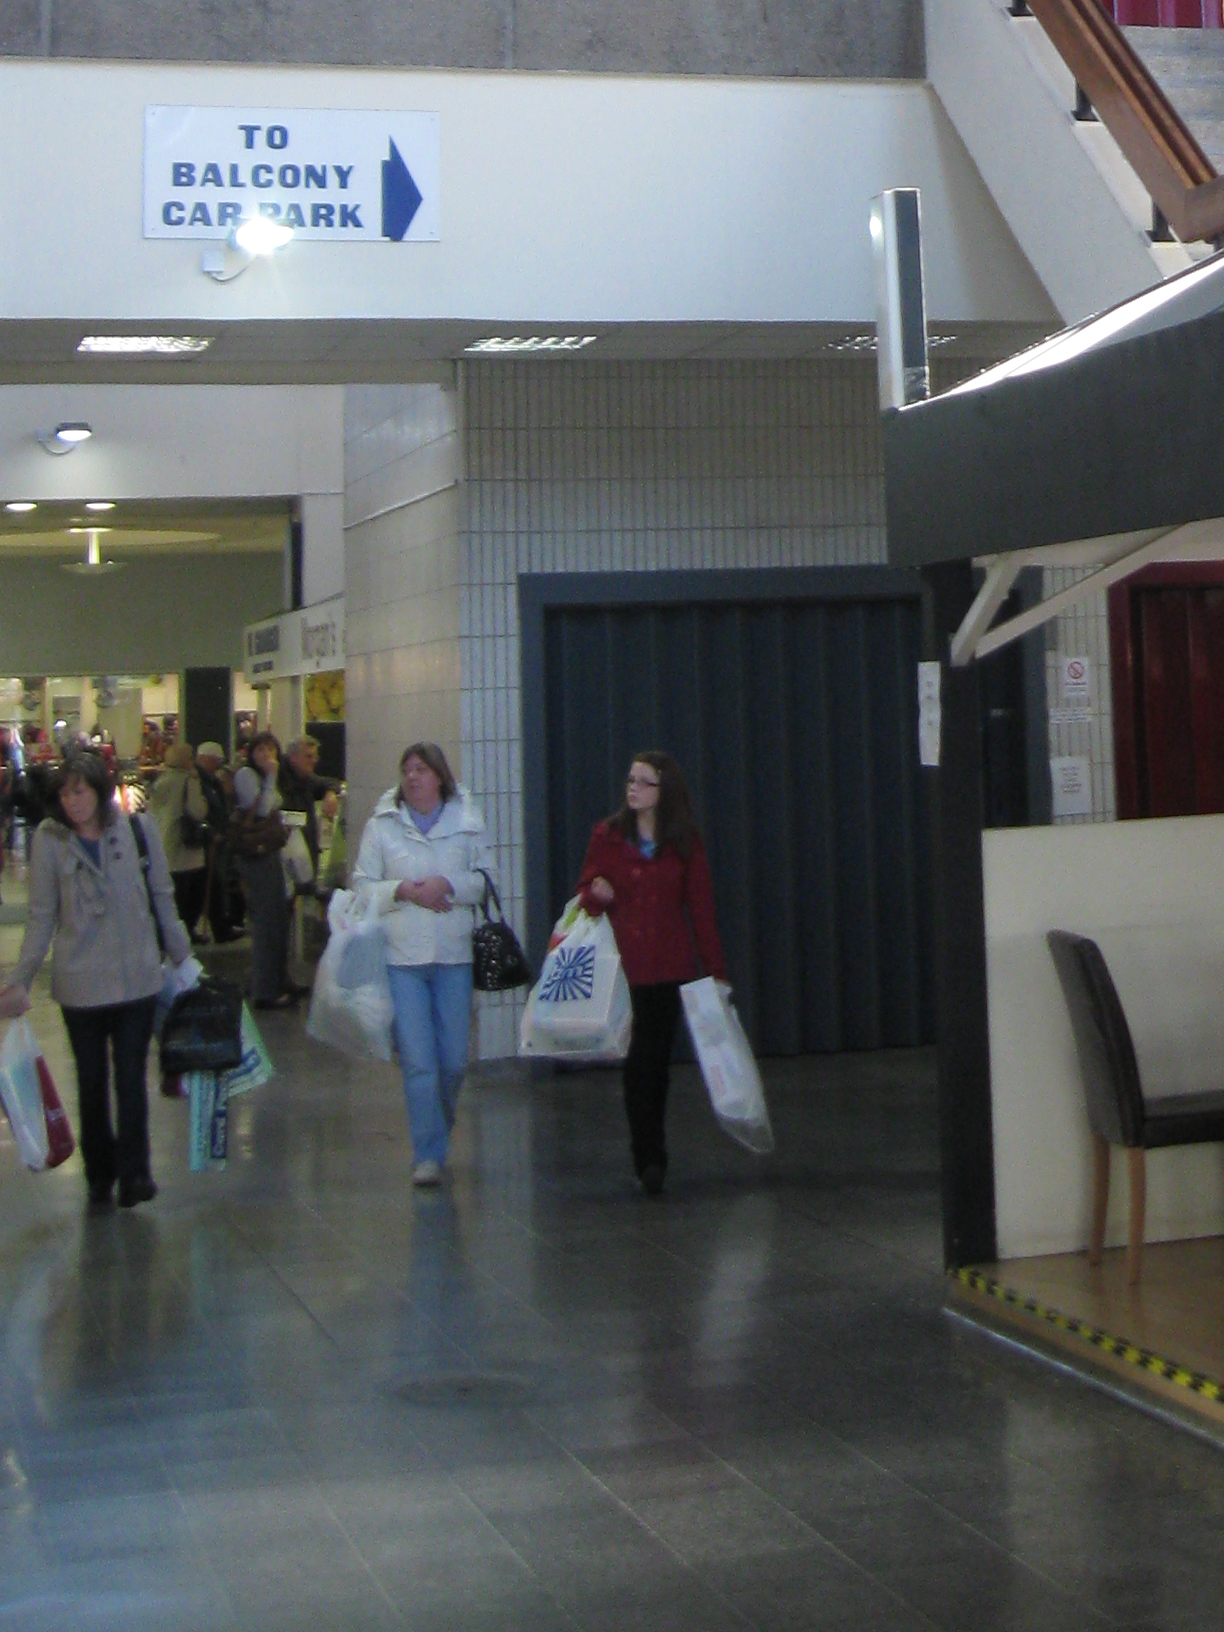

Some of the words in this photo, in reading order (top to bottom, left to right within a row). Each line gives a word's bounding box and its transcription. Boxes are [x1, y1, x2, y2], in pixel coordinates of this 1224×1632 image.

[238, 124, 289, 150] TO
[172, 161, 355, 190] BALCONY
[162, 200, 242, 228] CAR
